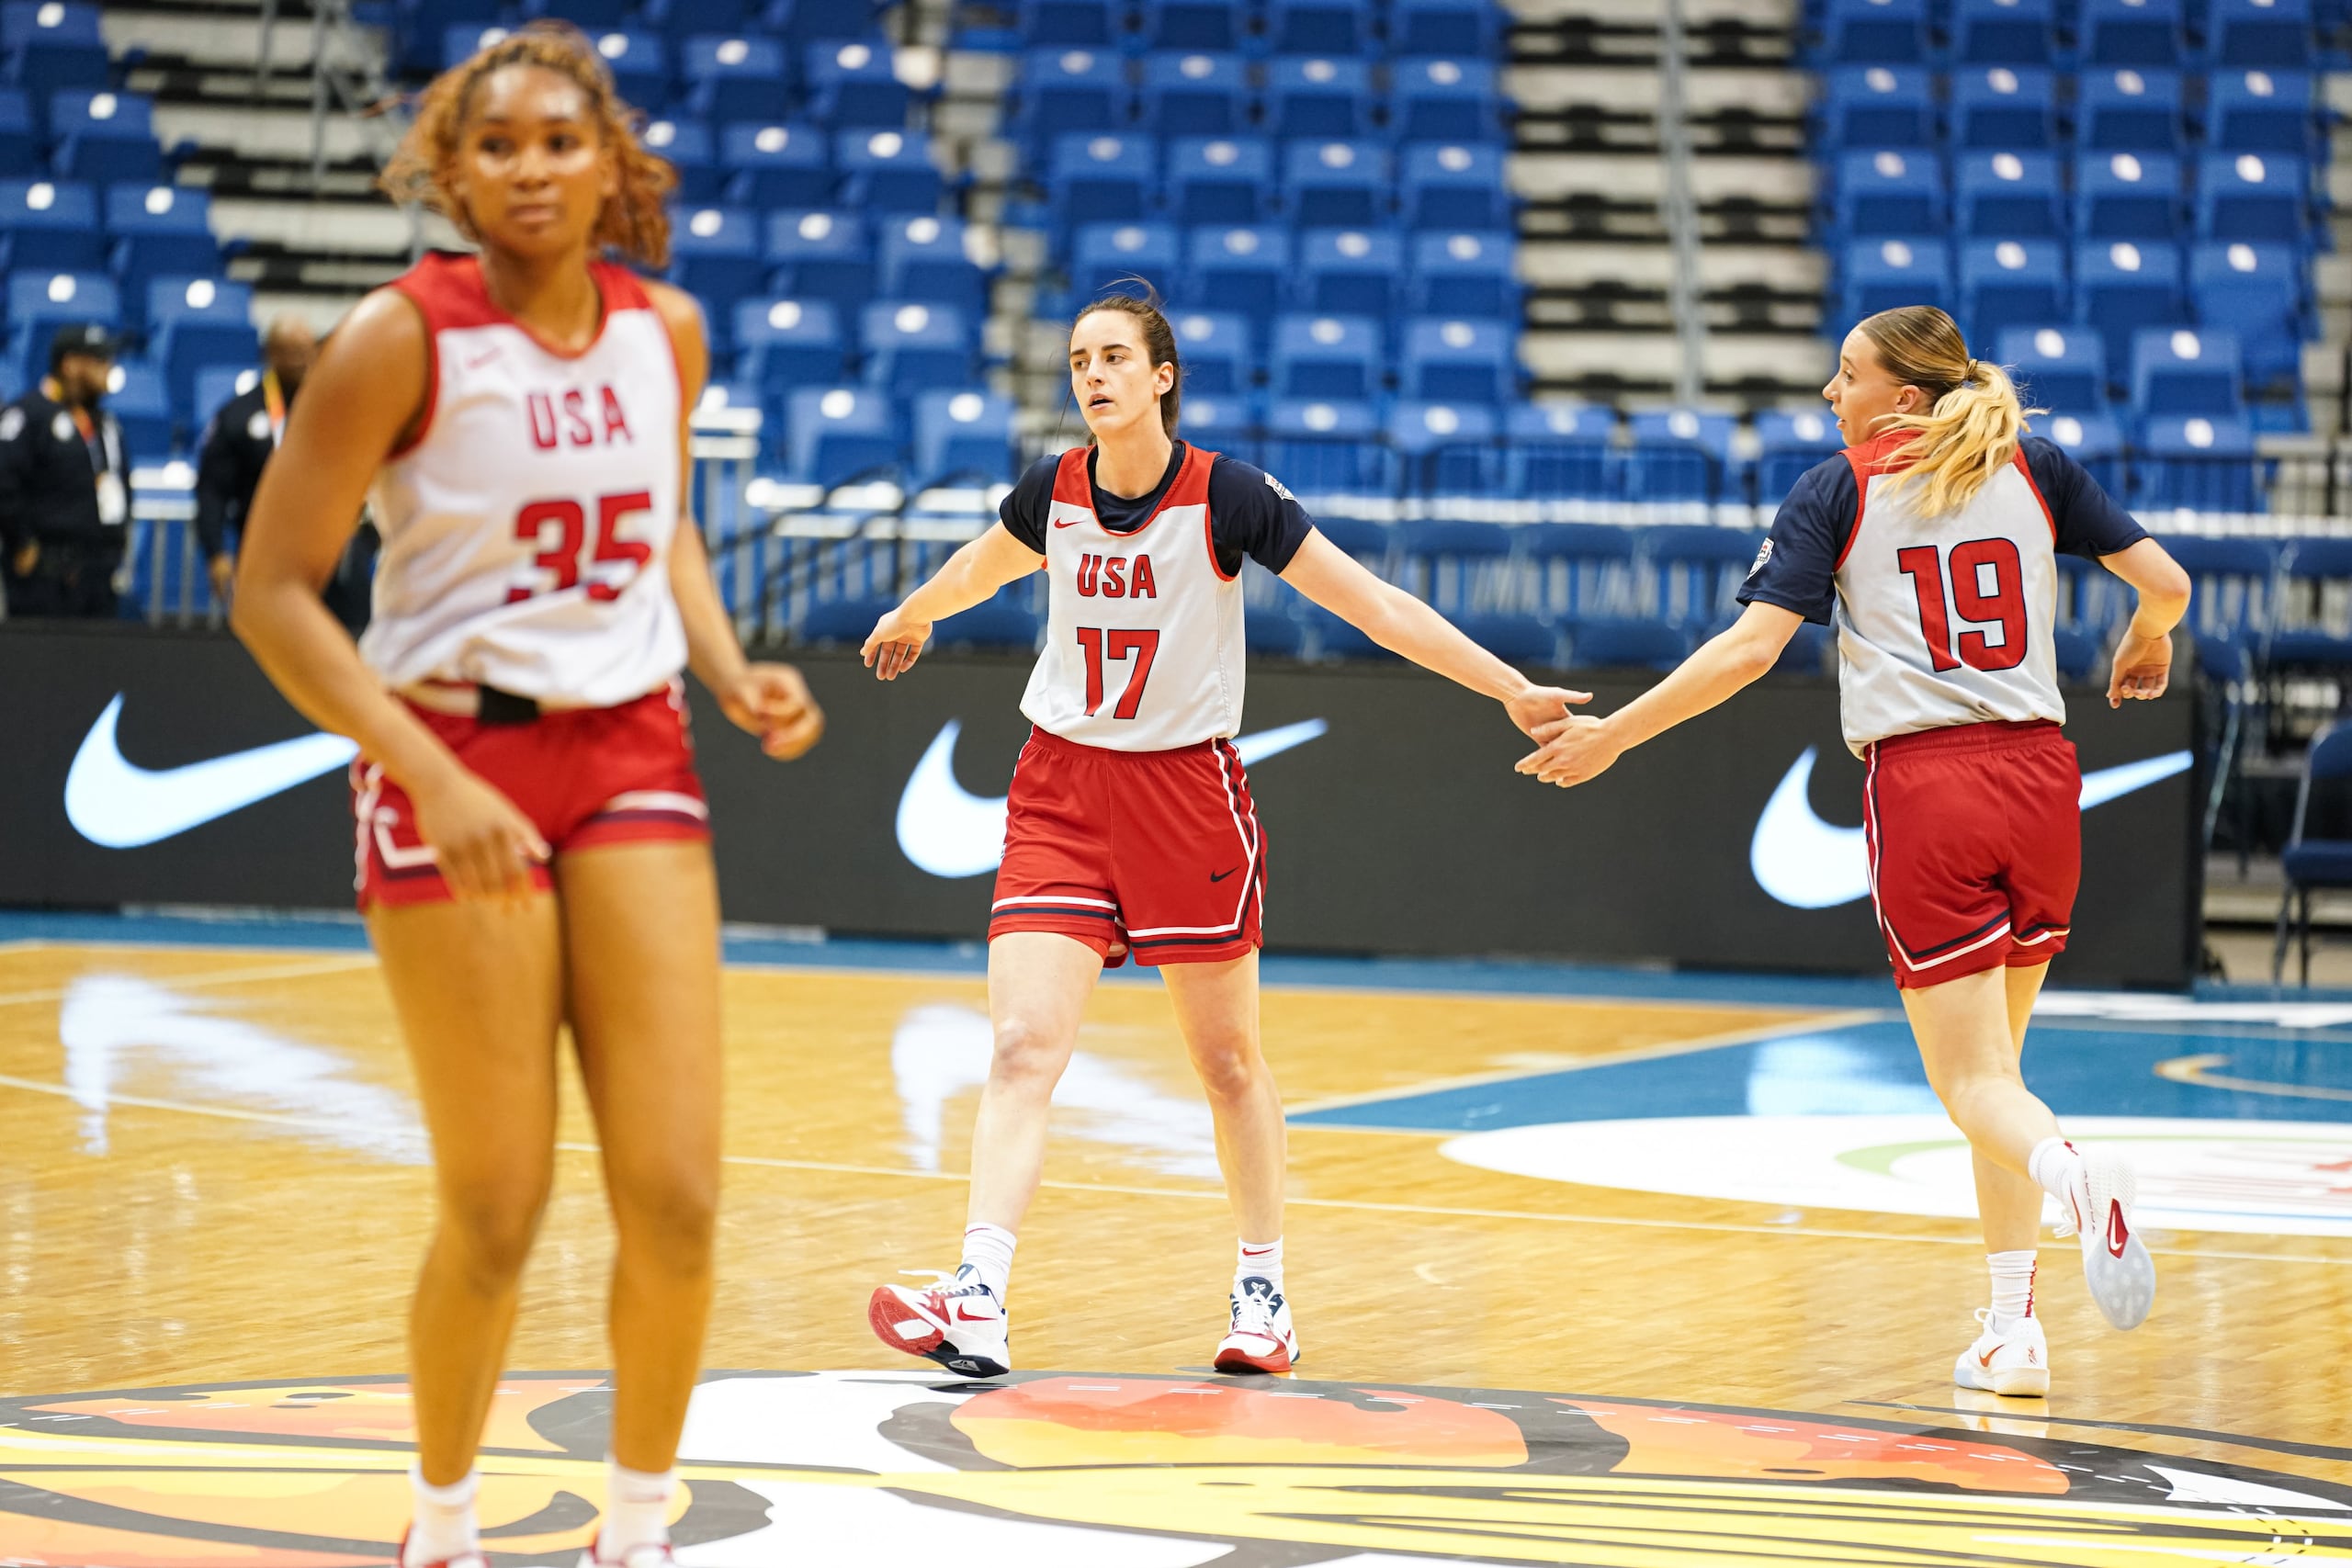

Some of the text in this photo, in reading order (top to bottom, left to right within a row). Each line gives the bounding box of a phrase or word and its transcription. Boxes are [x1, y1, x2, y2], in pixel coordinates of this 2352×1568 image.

[527, 386, 634, 448] USA
[506, 491, 652, 603] 35
[1077, 553, 1157, 598] USA
[1897, 537, 2028, 672] 19
[1077, 626, 1159, 719] 17
